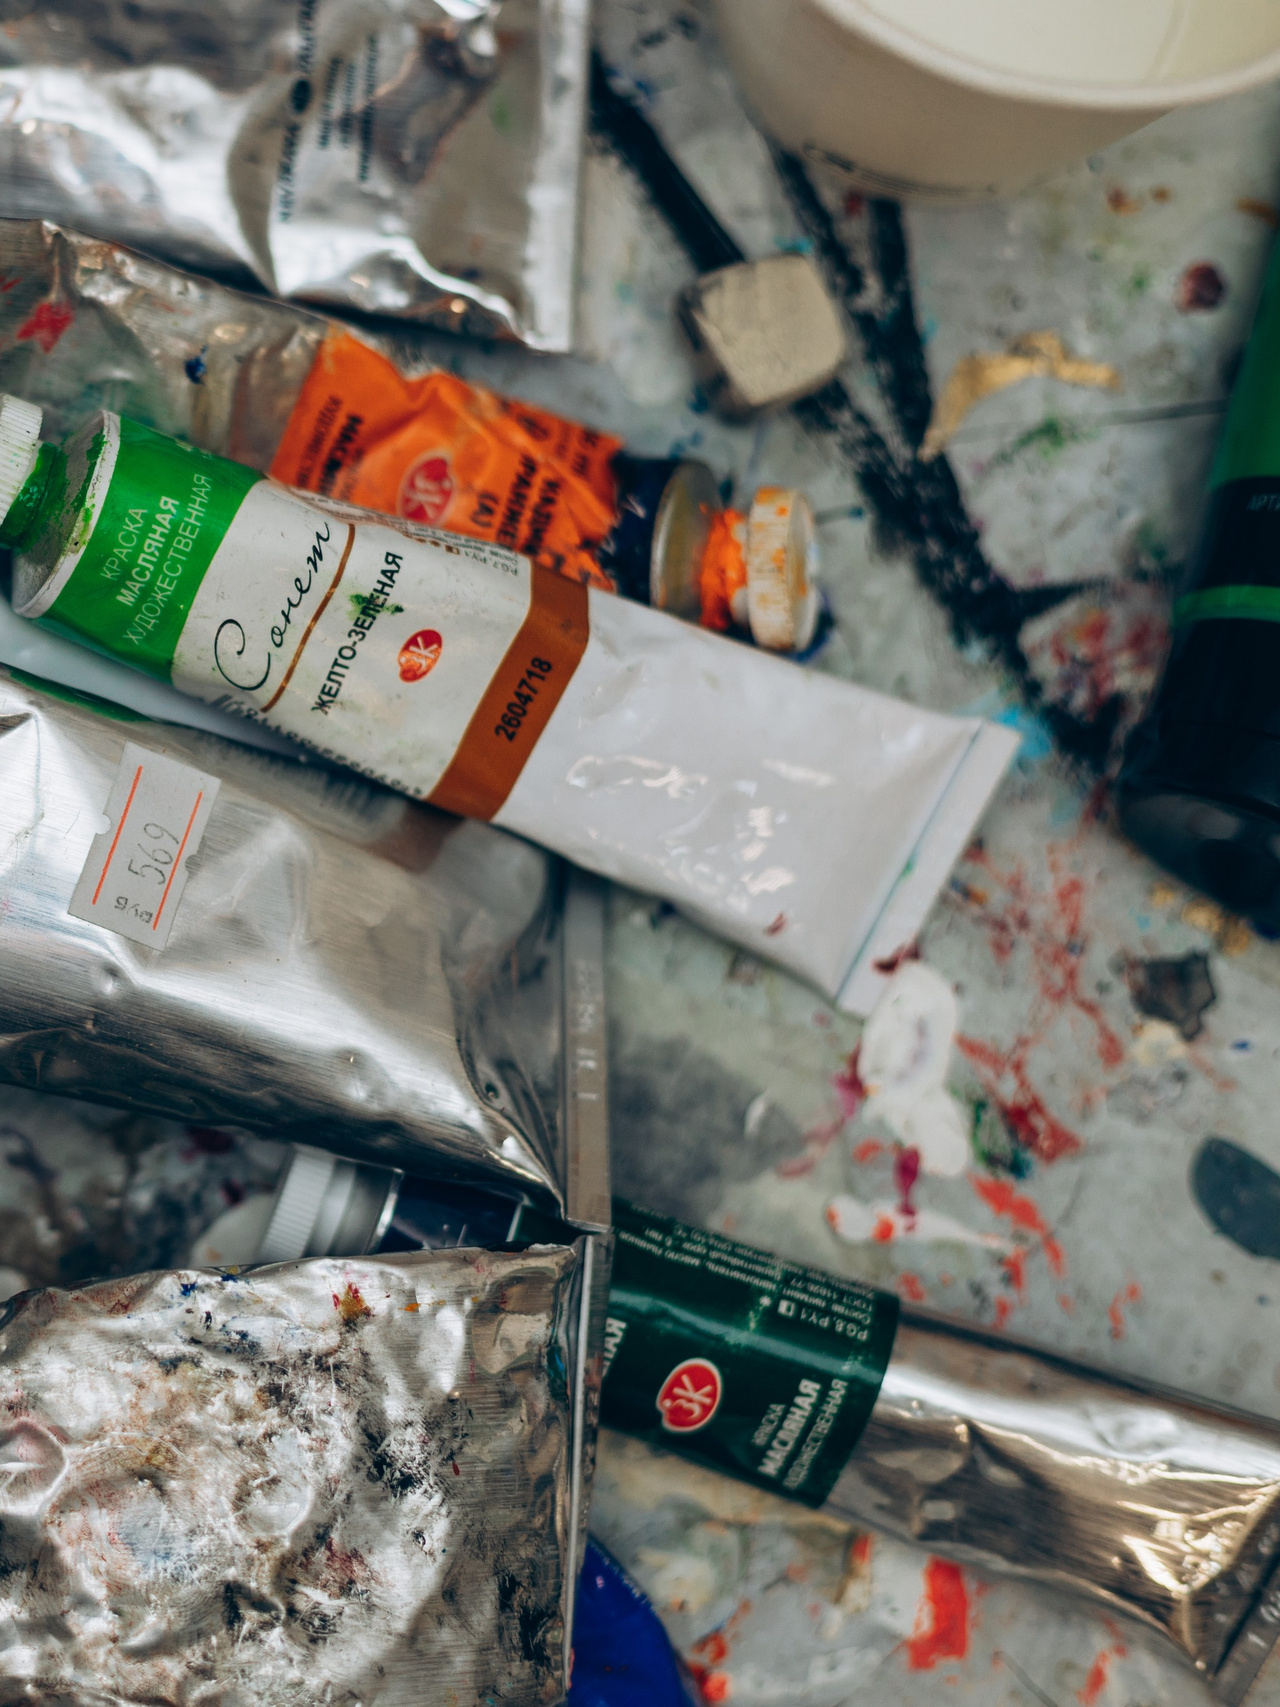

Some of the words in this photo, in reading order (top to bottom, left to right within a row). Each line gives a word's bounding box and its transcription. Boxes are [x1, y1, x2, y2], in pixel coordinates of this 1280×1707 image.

[100, 508, 148, 580] КРАСКА
[115, 494, 179, 608] МАСЛЯНАЯ
[121, 473, 212, 645] ХУДОЖЕСТВЕННАЯ
[214, 523, 331, 691] Сонет
[494, 657, 553, 745] 2604718
[125, 820, 179, 886] 569
[756, 1377, 821, 1476] МАСЛЯНАЯ
